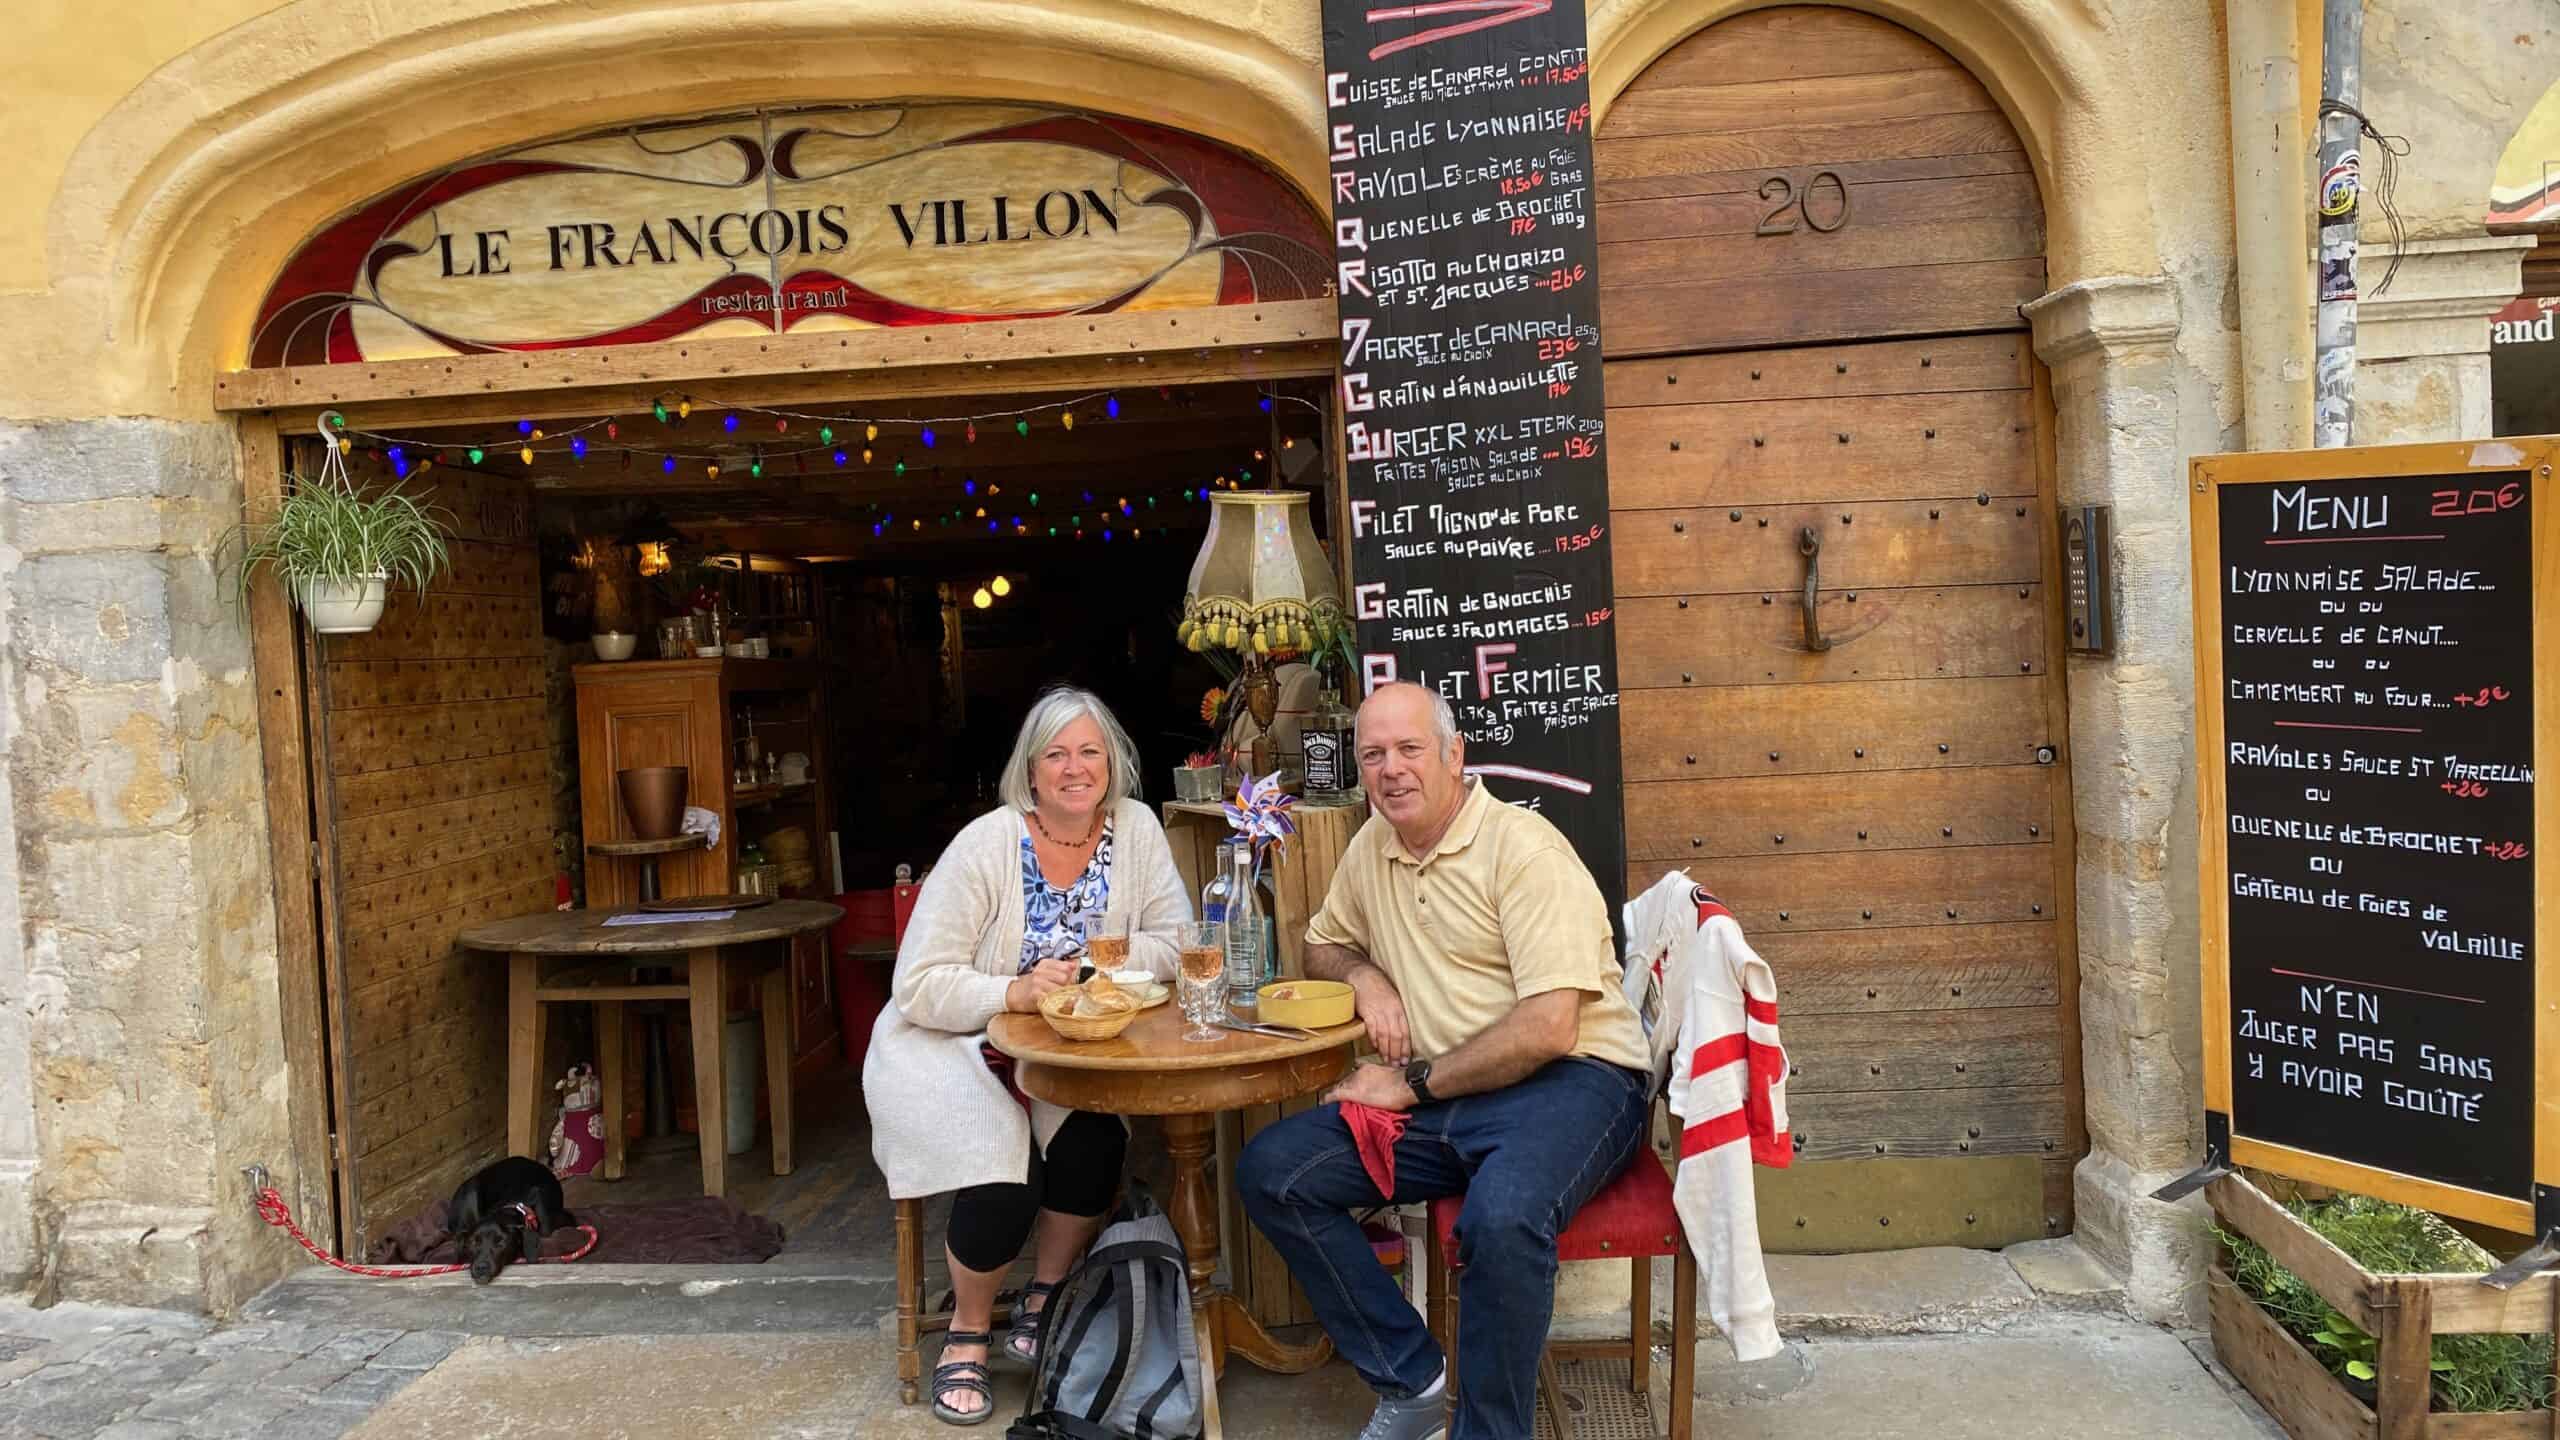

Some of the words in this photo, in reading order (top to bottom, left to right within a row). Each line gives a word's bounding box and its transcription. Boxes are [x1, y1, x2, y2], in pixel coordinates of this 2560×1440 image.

[1550, 169, 1583, 187] GRAS
[1337, 211, 1464, 251] QUENELLE
[1495, 189, 1586, 223] BROCHET
[1756, 172, 1848, 237] 20
[436, 229, 511, 278] LE
[547, 205, 849, 274] FRANÇOIS
[887, 187, 1124, 250] VILLON
[701, 285, 849, 314] restaurant
[1431, 275, 1529, 311] JACQUES
[2490, 310, 2554, 344] and
[1538, 336, 1581, 361] 23€
[1346, 421, 1468, 462] BURGER
[1475, 424, 1513, 446] XXL
[1519, 414, 1577, 440] STEAK
[1447, 473, 1486, 493] SAUCE
[2271, 485, 2388, 532] MENU
[2431, 482, 2525, 517] 20€
[1384, 541, 1437, 560] SAUCE
[1391, 624, 1447, 642] SAUCE
[1462, 612, 1569, 640] FROMAGES
[2234, 624, 2324, 645] CERVELLE
[2338, 750, 2402, 777] SAUCE
[2408, 756, 2435, 778] ST
[2231, 814, 2334, 843] QUENELLE
[2364, 826, 2483, 856] BROCHET
[2300, 983, 2380, 1026] N'EN
[2239, 1009, 2318, 1051] JUGER
[2338, 1031, 2395, 1065] PAS
[2419, 1043, 2495, 1083] SANS
[2383, 1080, 2485, 1123] GOÛTÉ
